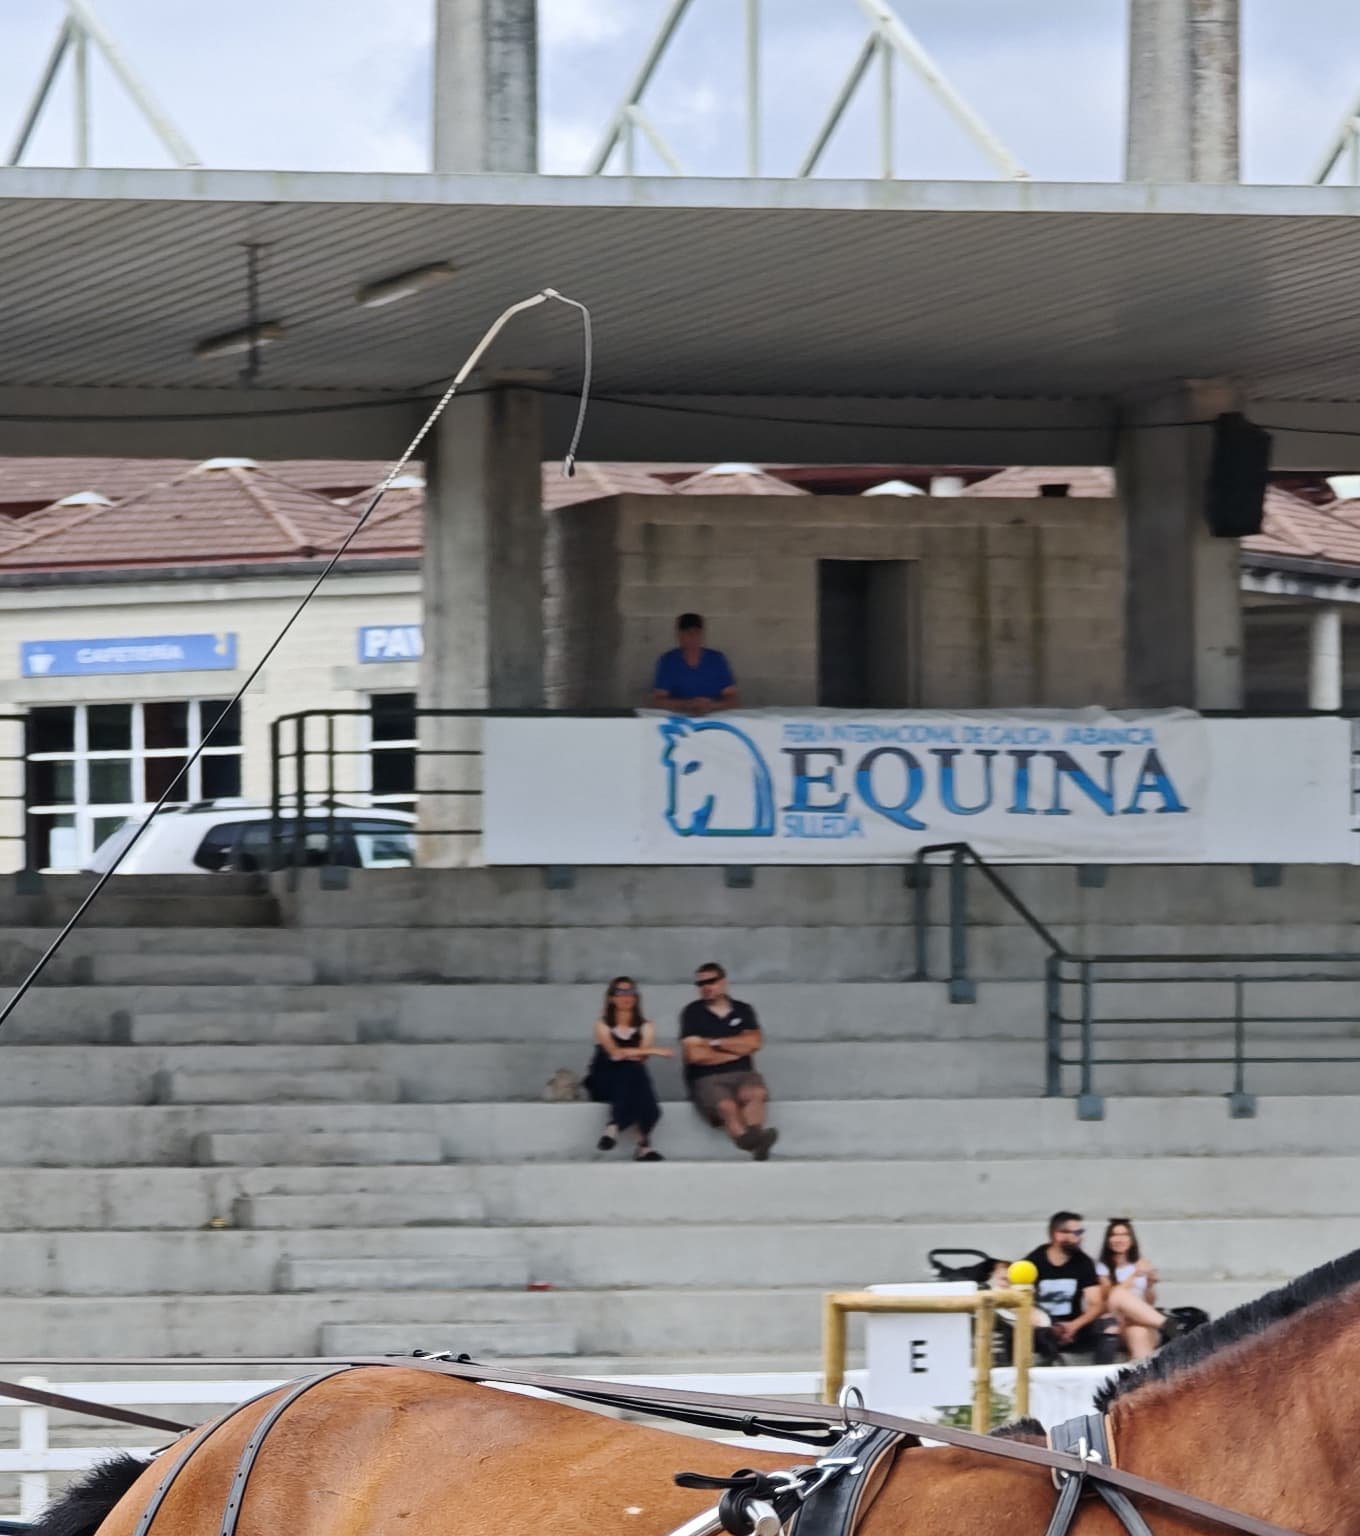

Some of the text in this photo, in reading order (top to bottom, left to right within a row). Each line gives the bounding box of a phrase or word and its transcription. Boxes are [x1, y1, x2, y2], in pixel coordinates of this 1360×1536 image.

[781, 747, 1189, 830] EQUINA
[783, 815, 863, 839] SILLEDA
[909, 1339, 928, 1374] E
